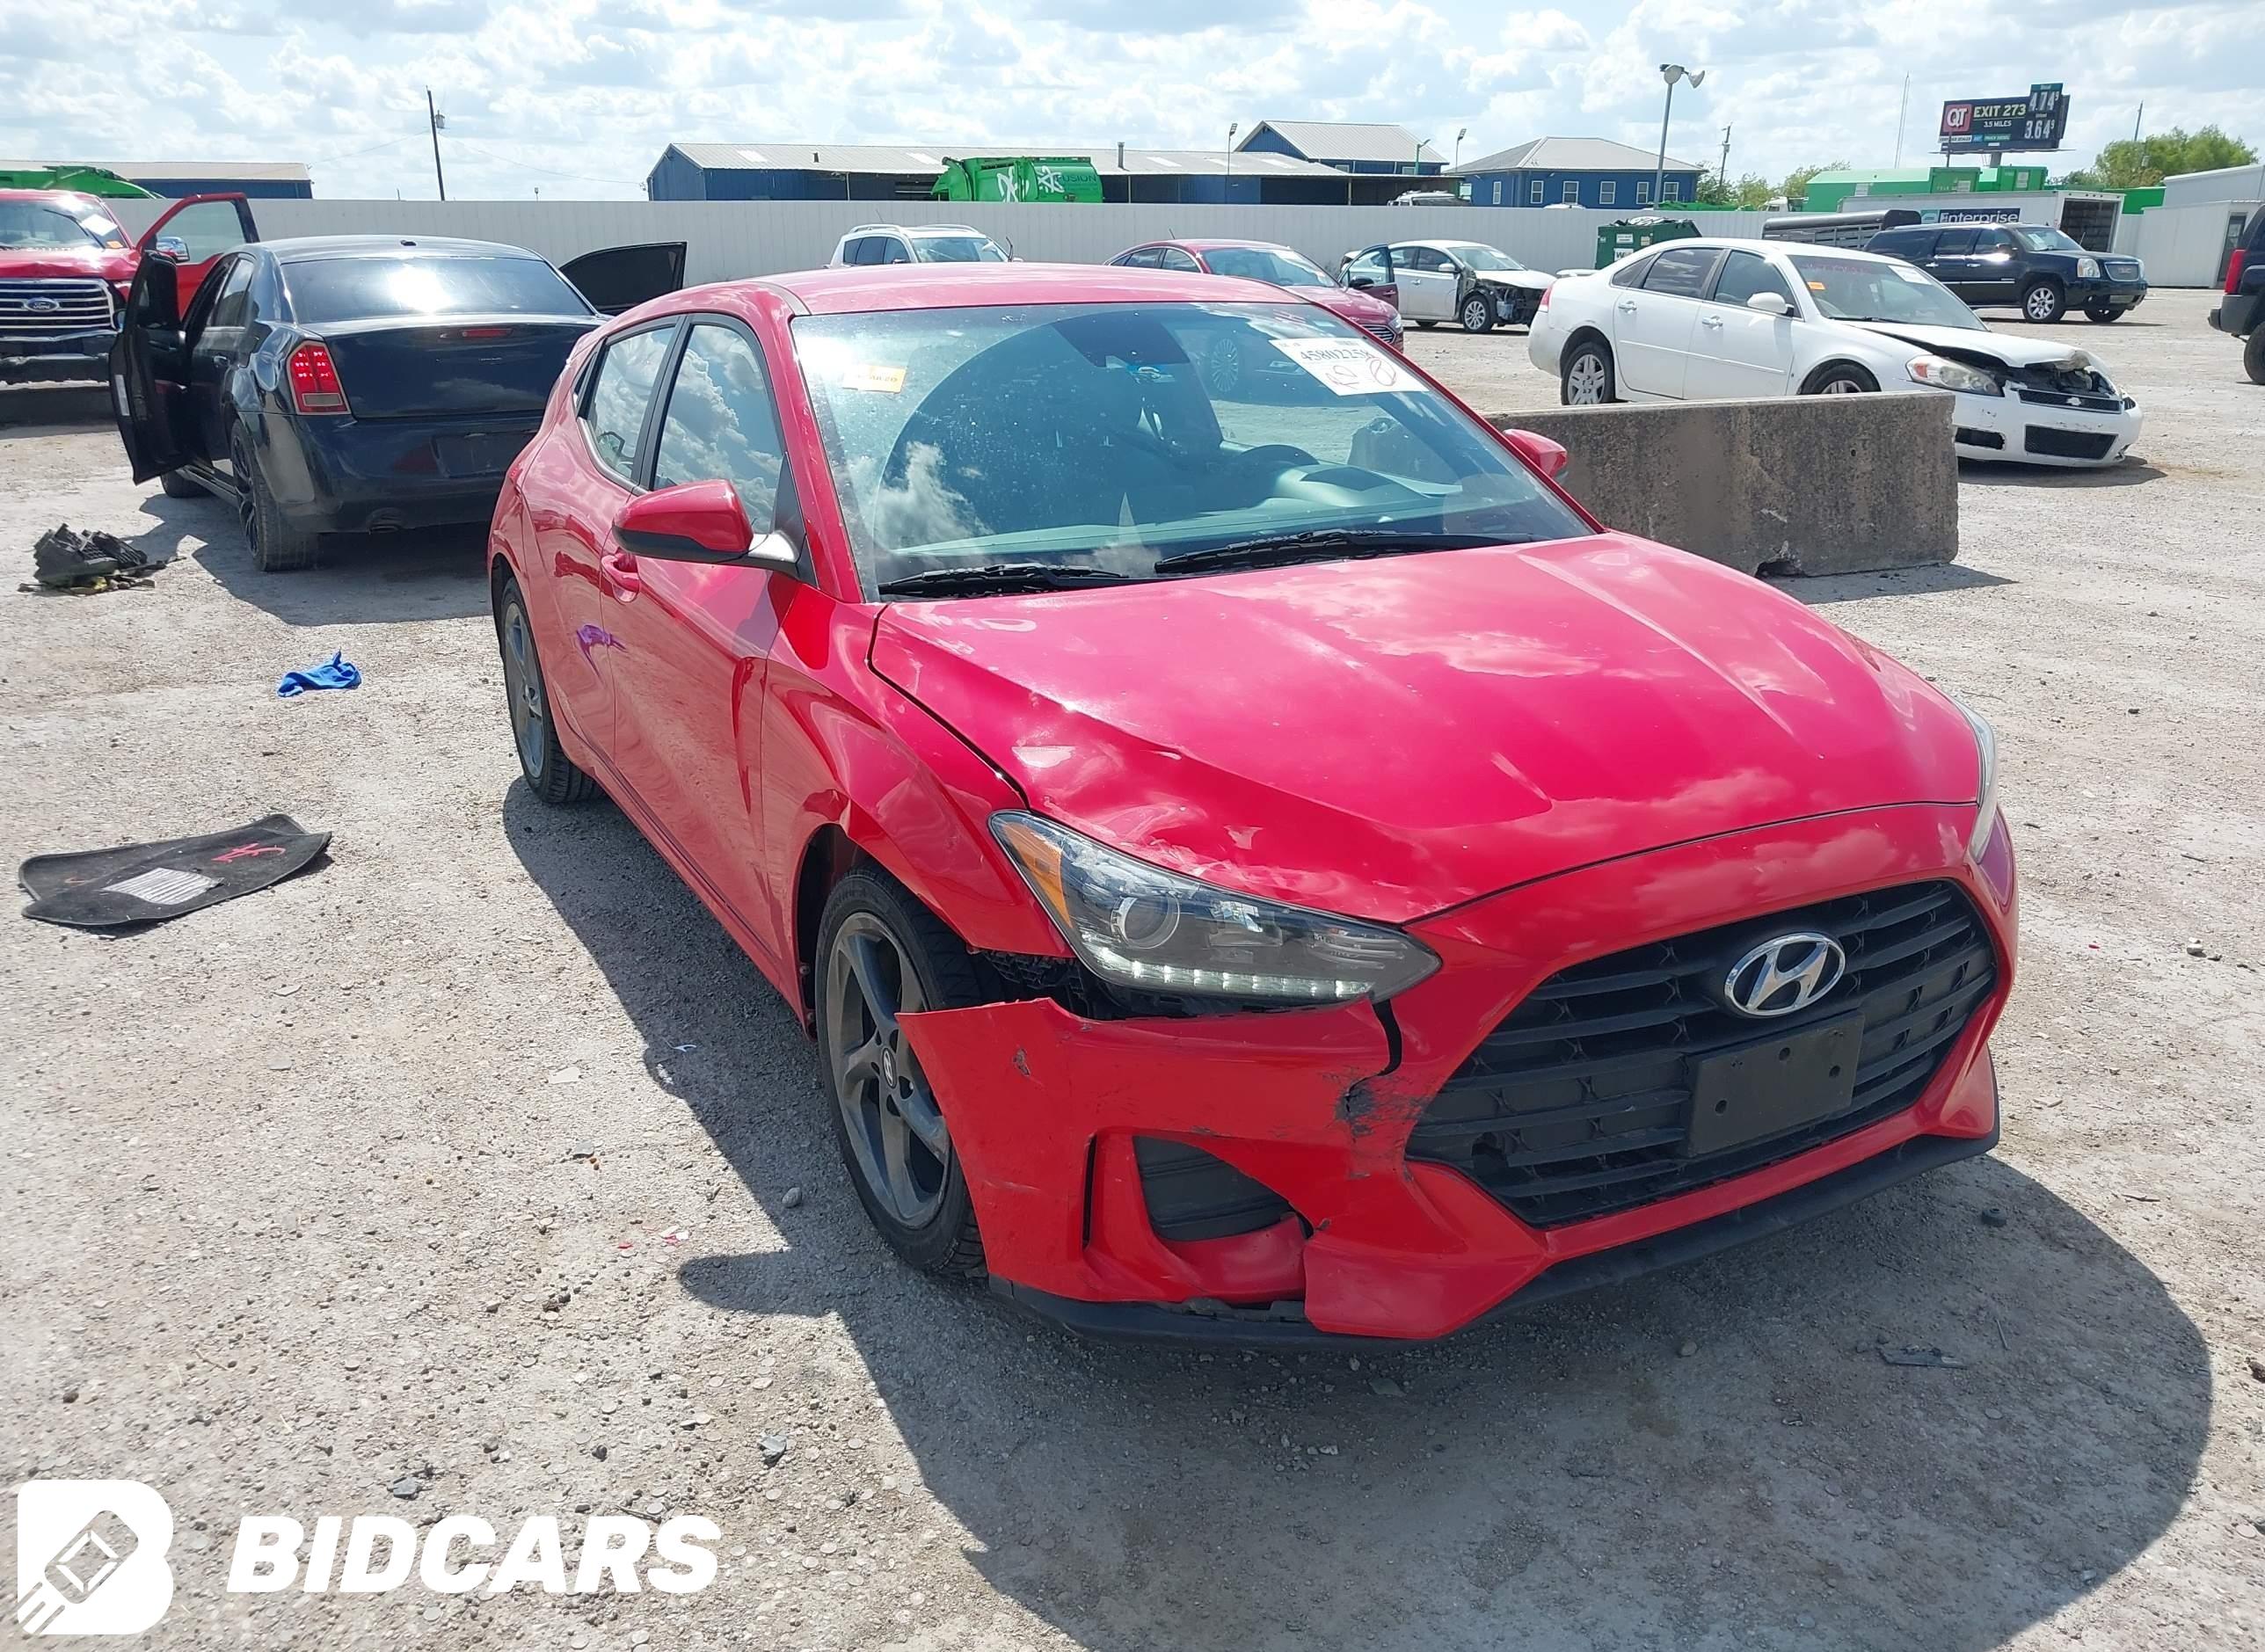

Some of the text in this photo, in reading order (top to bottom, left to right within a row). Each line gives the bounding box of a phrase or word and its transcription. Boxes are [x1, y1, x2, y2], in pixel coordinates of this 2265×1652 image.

[1947, 107, 1967, 127] QT
[1973, 104, 2027, 118] EXIT 273
[1940, 210, 2019, 223] Enterprise
